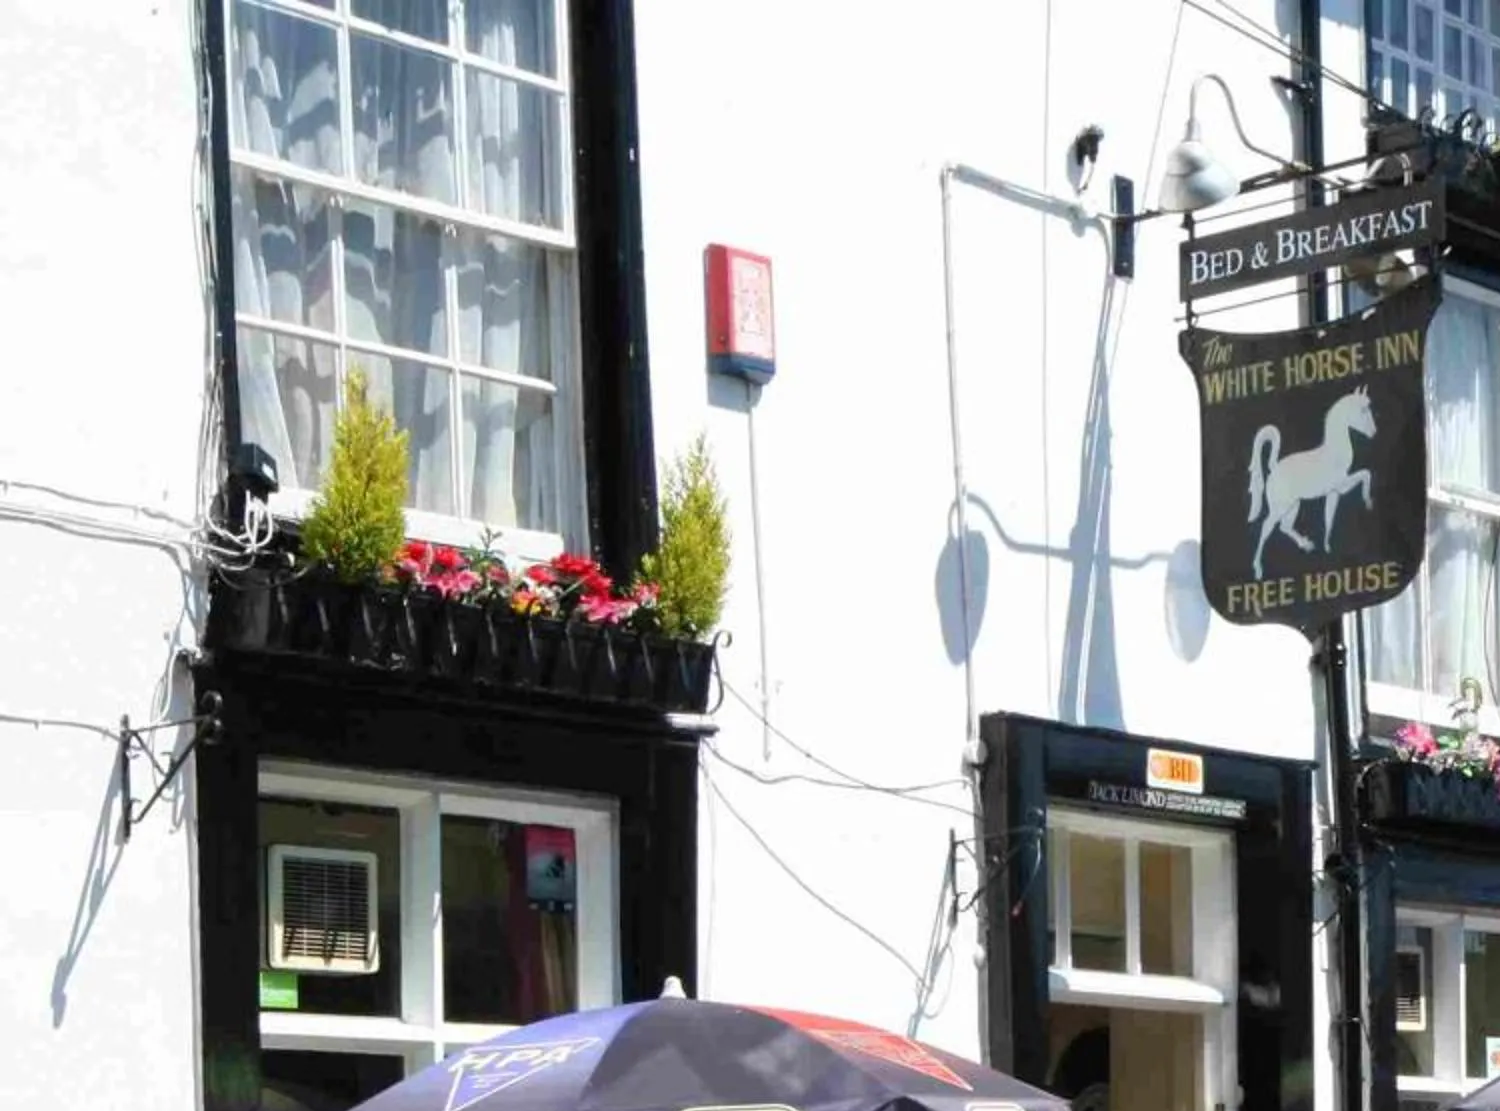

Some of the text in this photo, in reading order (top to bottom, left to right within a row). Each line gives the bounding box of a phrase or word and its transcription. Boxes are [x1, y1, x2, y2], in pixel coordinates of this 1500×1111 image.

[1189, 200, 1433, 285] BED & BREAKFAST
[1203, 334, 1234, 369] The
[1203, 329, 1421, 404] WHITE HORSE INN
[1226, 561, 1402, 618] FREE HOUSE
